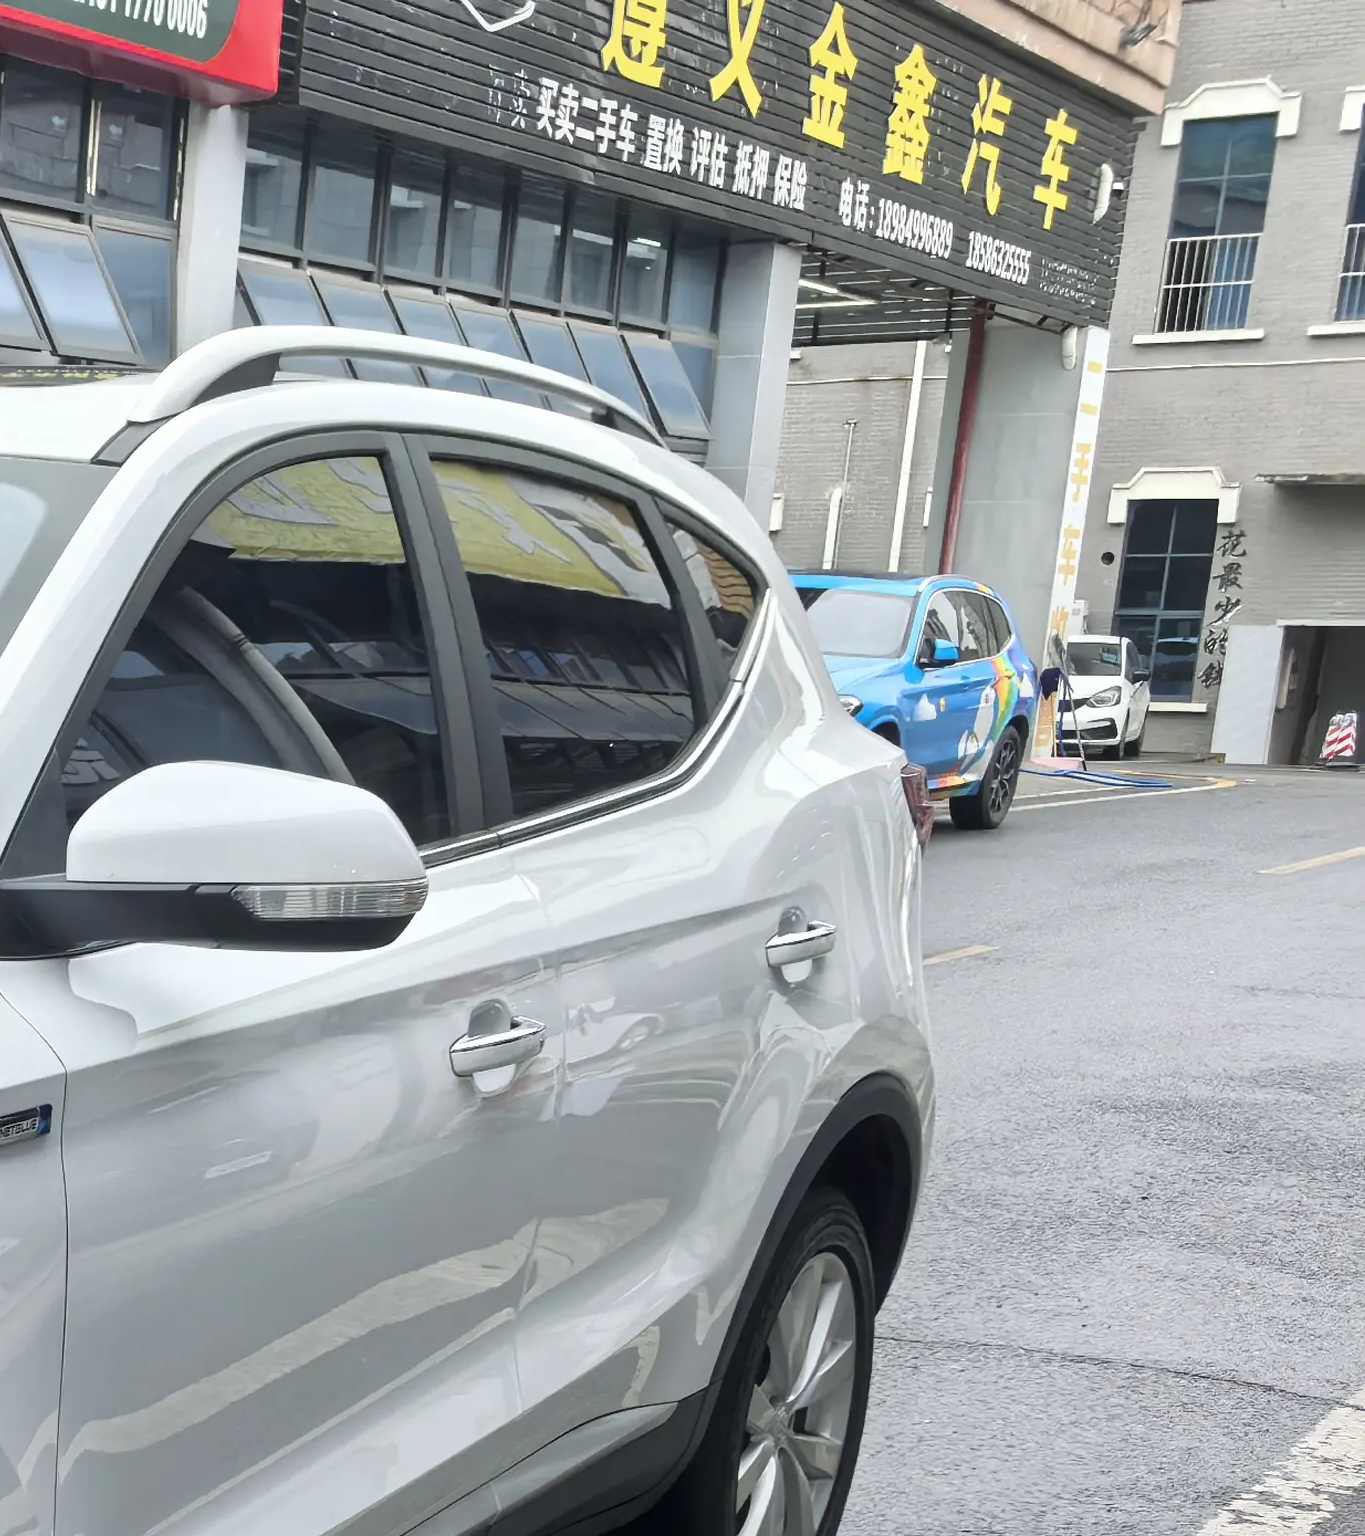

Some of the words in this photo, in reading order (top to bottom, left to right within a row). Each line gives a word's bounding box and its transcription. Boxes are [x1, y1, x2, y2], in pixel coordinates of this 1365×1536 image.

[535, 77, 638, 162] 买卖二手车
[643, 113, 685, 176] 置换
[690, 127, 728, 189] 评估
[731, 140, 769, 199] 抵押
[773, 153, 808, 211] 保险
